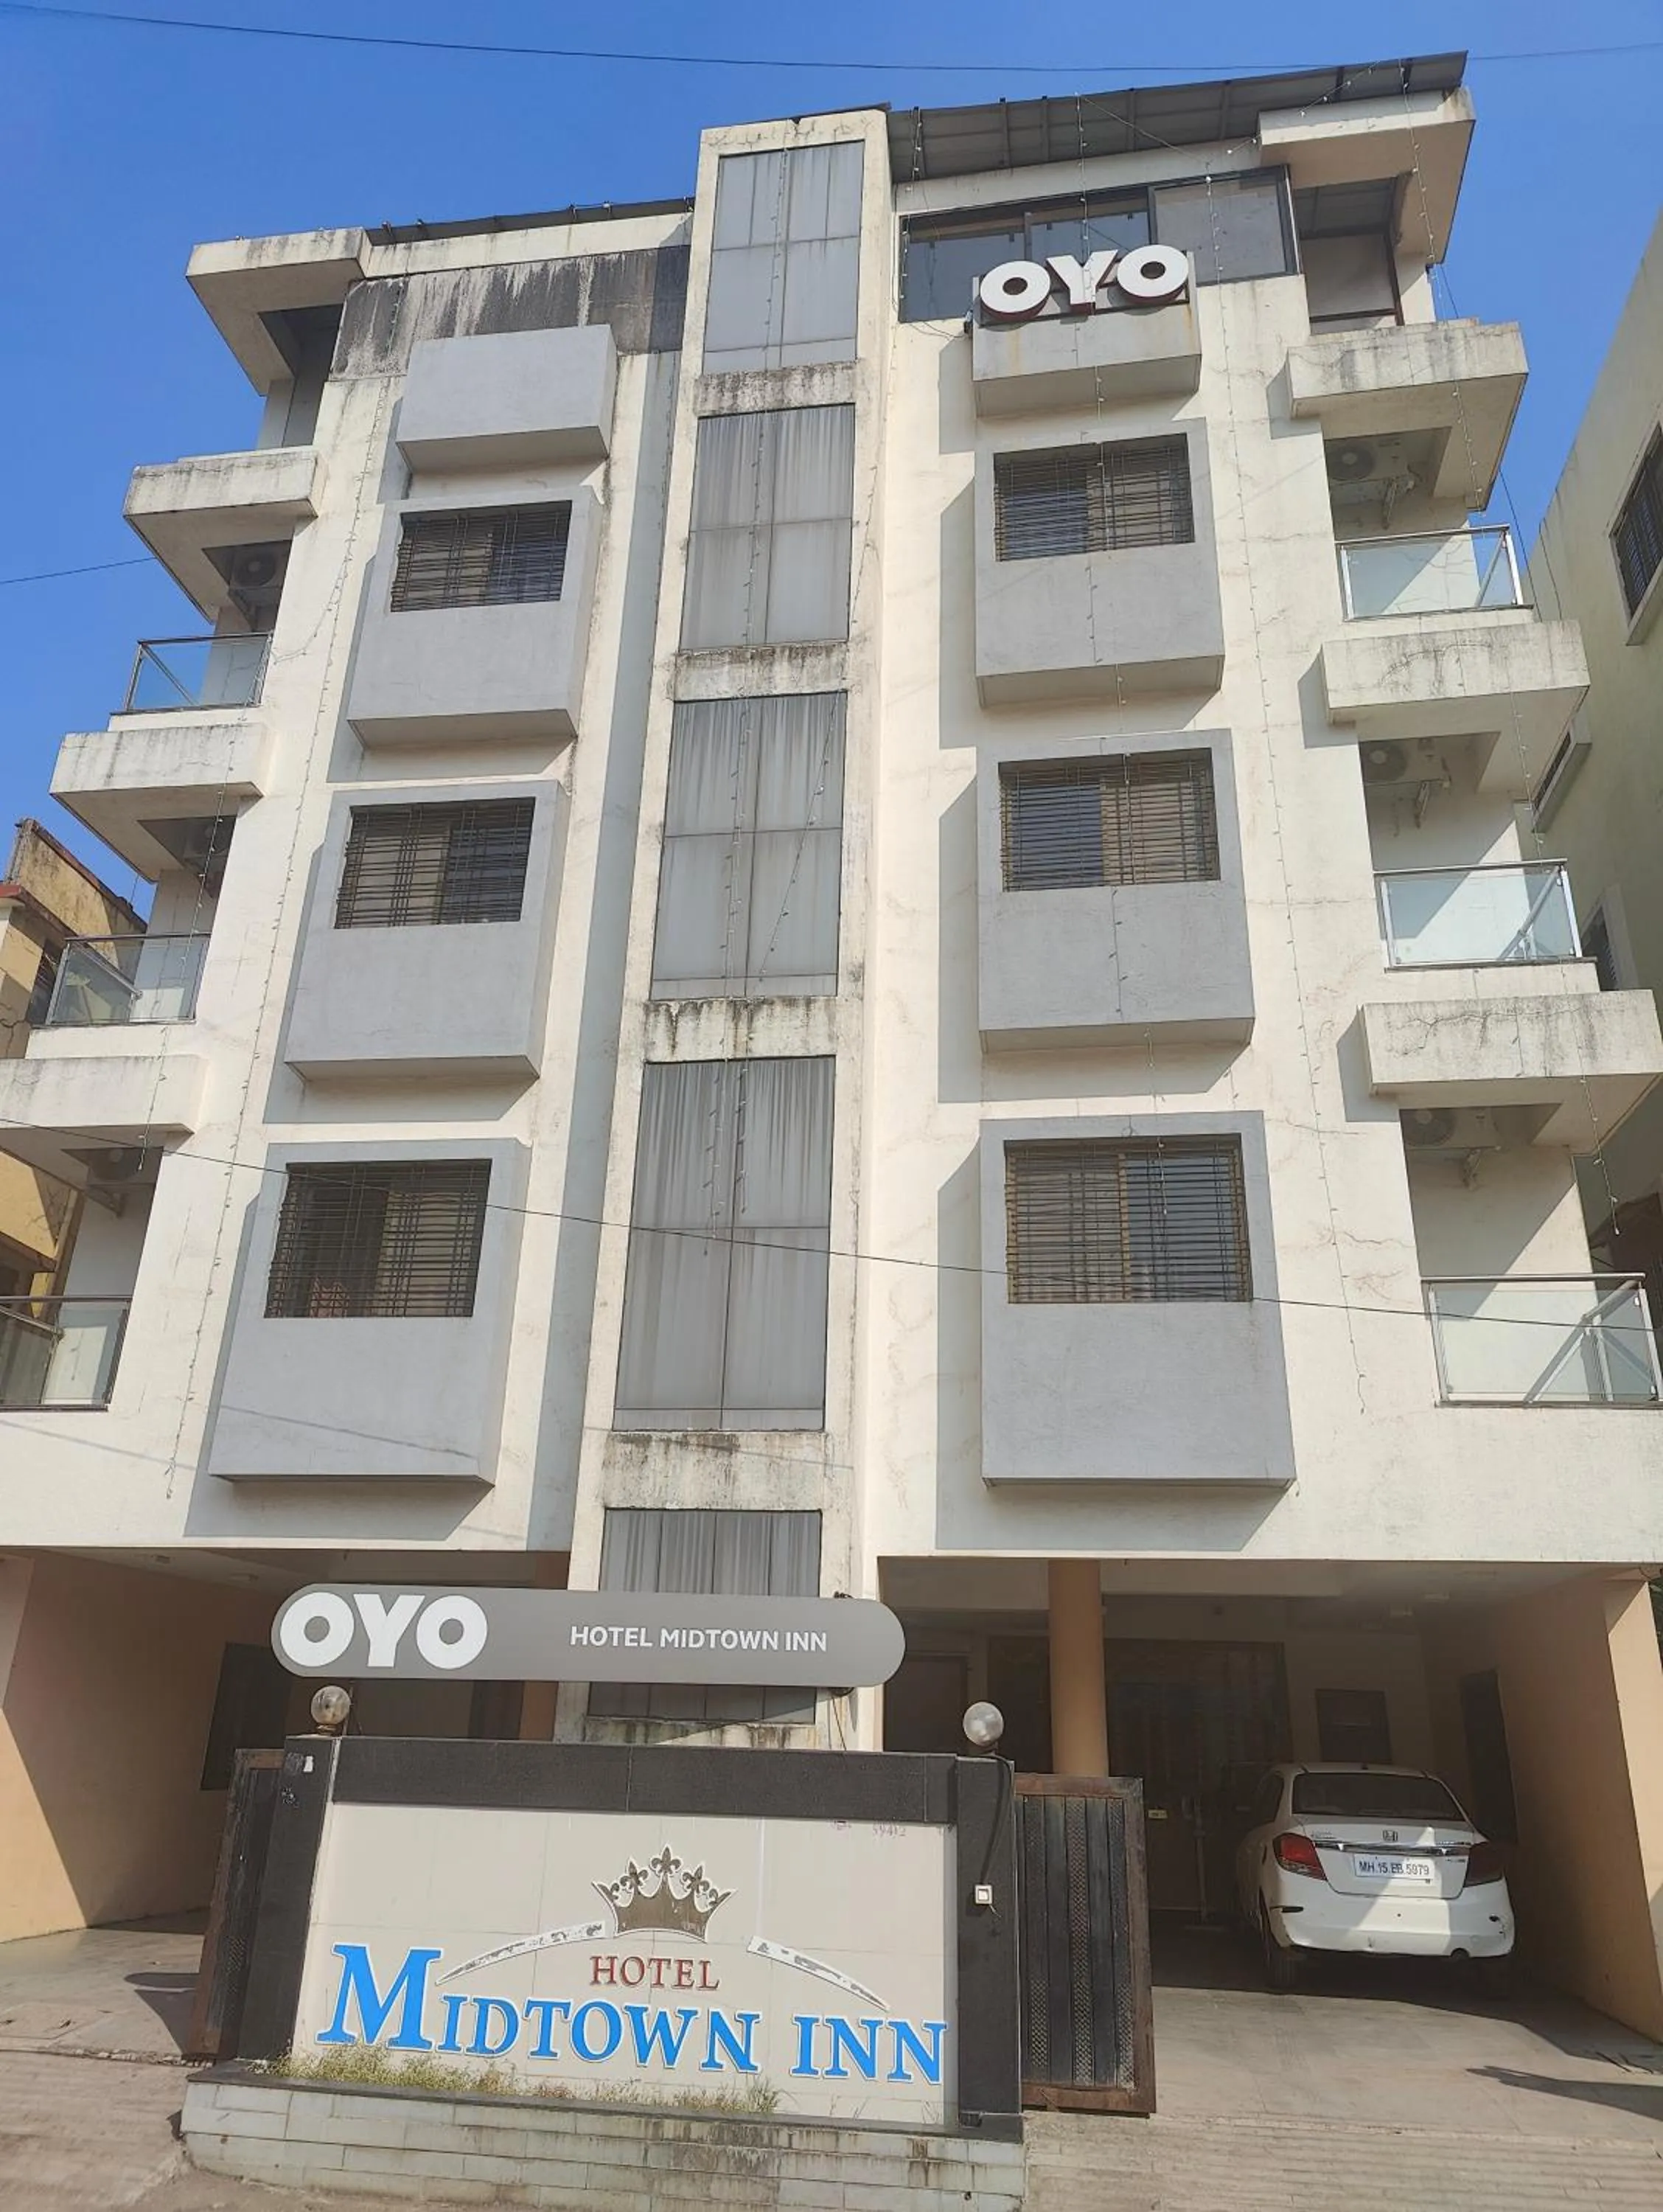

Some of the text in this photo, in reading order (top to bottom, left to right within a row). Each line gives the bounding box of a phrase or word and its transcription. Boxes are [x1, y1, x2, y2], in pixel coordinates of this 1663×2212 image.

[980, 244, 1189, 319] OYO
[279, 1591, 488, 1669] OYO
[570, 1625, 827, 1652] HOTEL MIDTOWN INN
[589, 1955, 720, 1992] HOTEL
[315, 1944, 949, 2085] MIDTOWN INN
